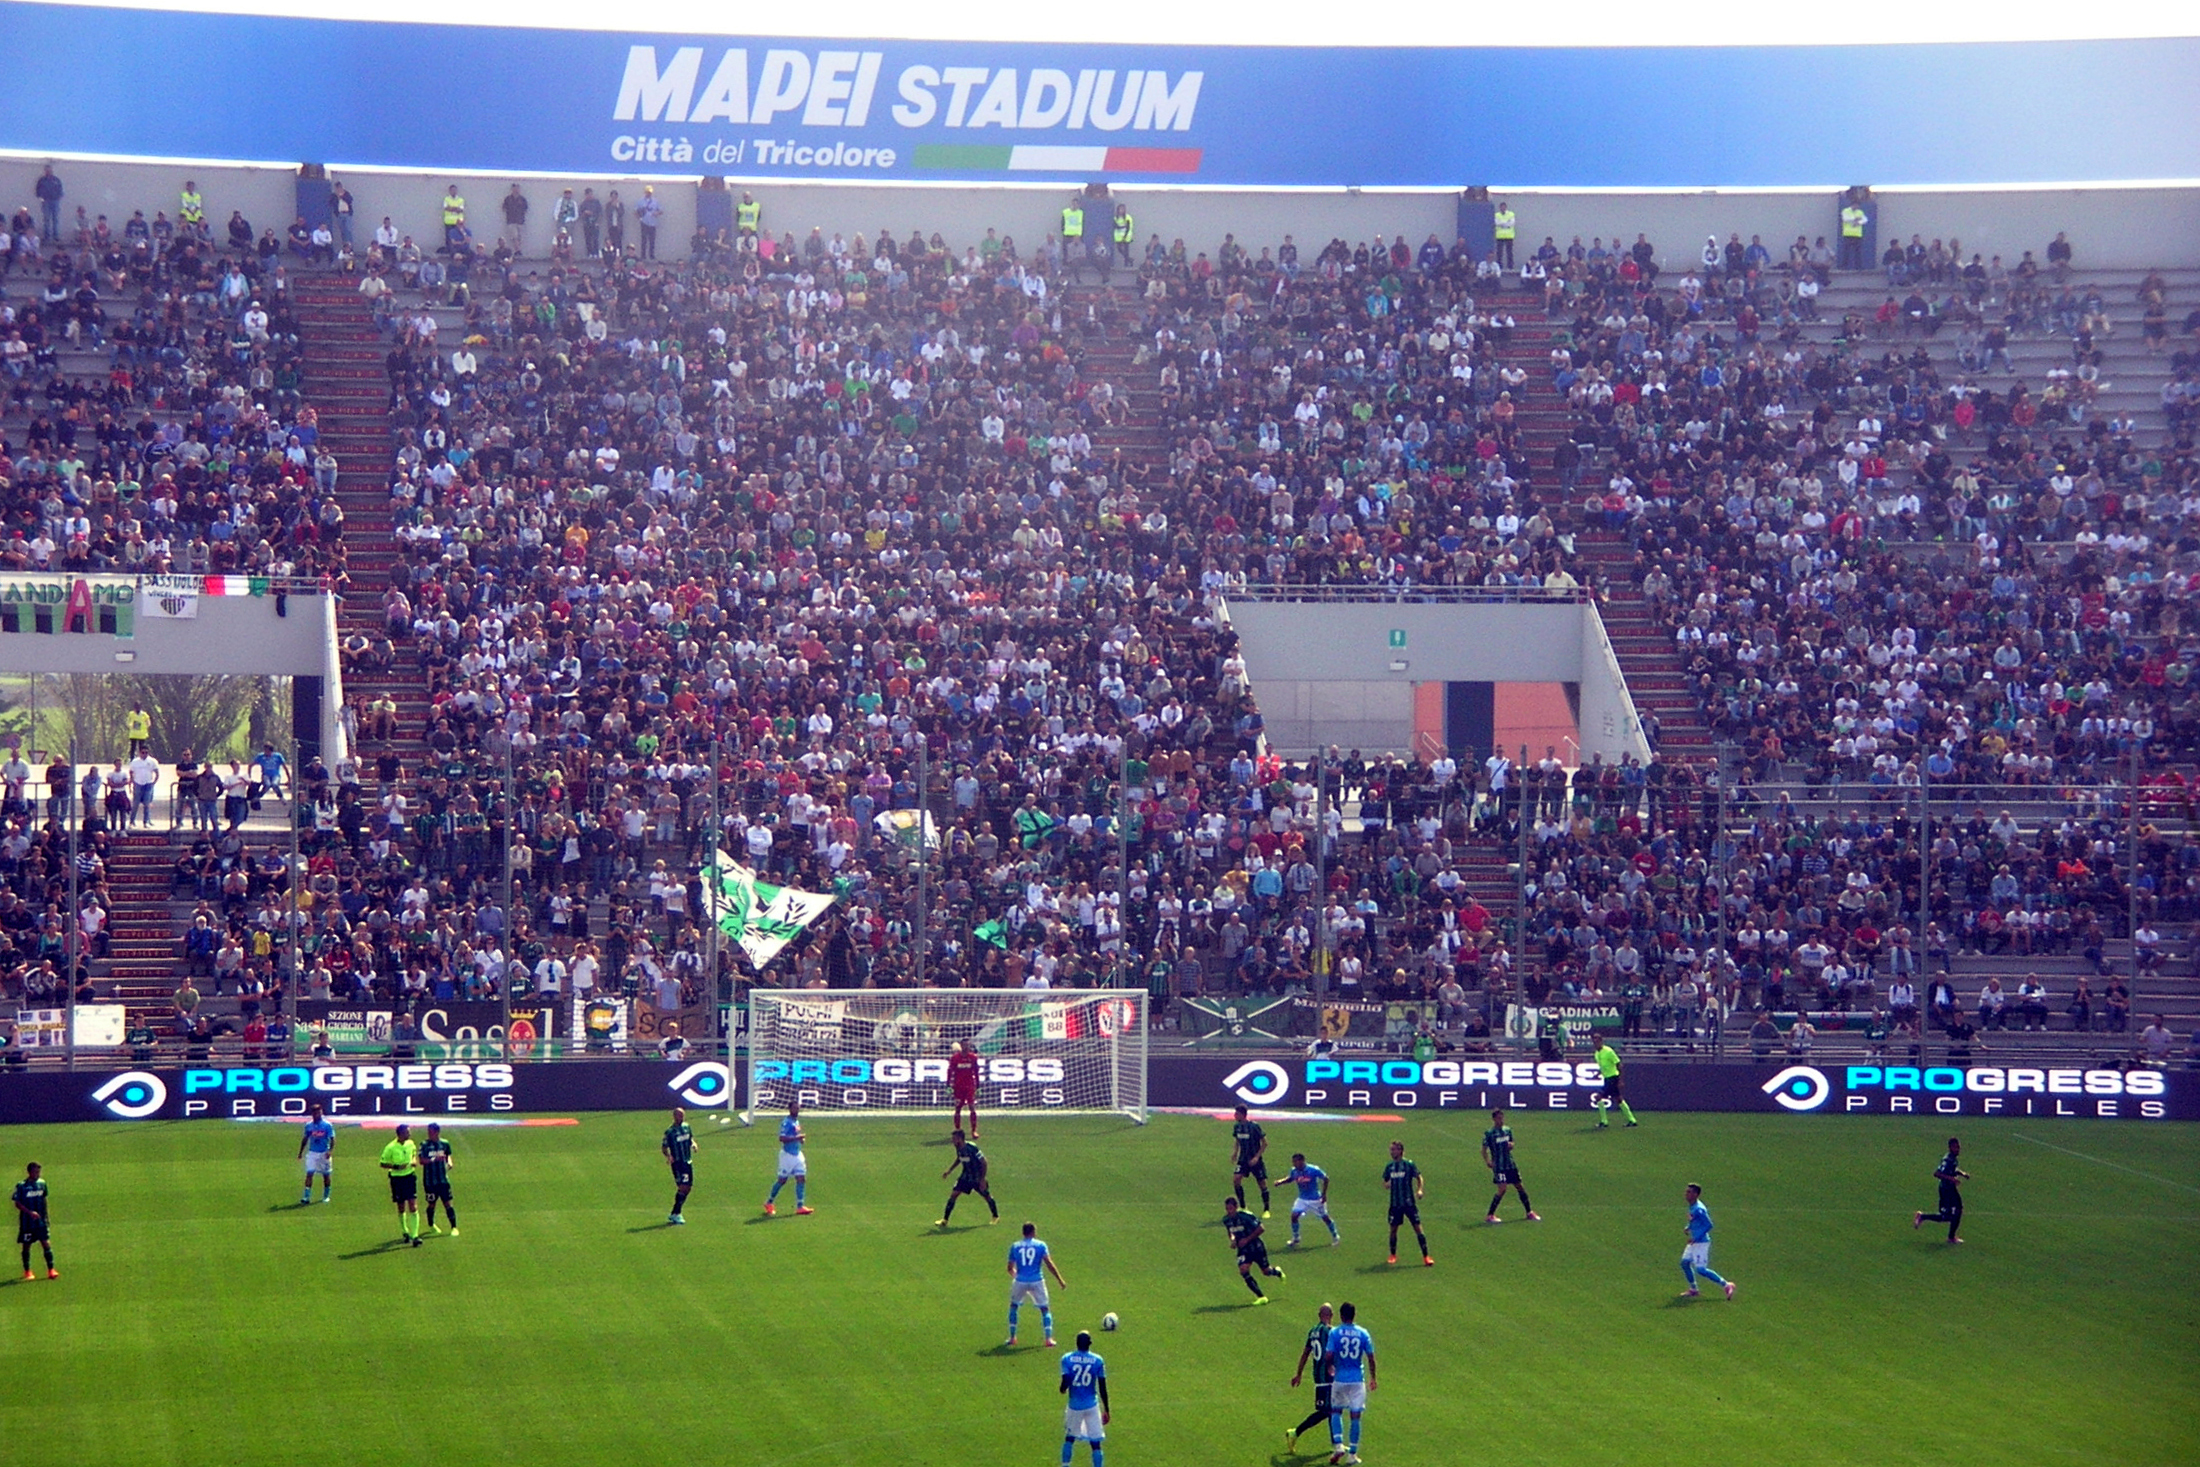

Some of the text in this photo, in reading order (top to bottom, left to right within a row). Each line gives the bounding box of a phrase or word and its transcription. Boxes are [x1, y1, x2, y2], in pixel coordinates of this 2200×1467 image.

[613, 45, 1204, 131] MAPEI STADIUM
[611, 135, 896, 168] Città del Tricolore
[1539, 1007, 1619, 1018] GADINATA
[1047, 1021, 1063, 1032] 88
[1565, 1021, 1592, 1032] SUD
[185, 1064, 514, 1094] PROGRESS
[754, 1058, 1065, 1085] PROGRSS
[1305, 1060, 1605, 1087] PROGRESS
[1846, 1066, 2166, 1095] PROGRESS
[185, 1094, 514, 1117] PROFILES
[754, 1088, 1064, 1107] PROFIES
[1305, 1090, 1612, 1108] PROFILES
[1845, 1095, 2166, 1118] PROFILES
[1019, 1247, 1035, 1266] 19
[1339, 1336, 1360, 1359] 33
[1072, 1364, 1092, 1387] 26
